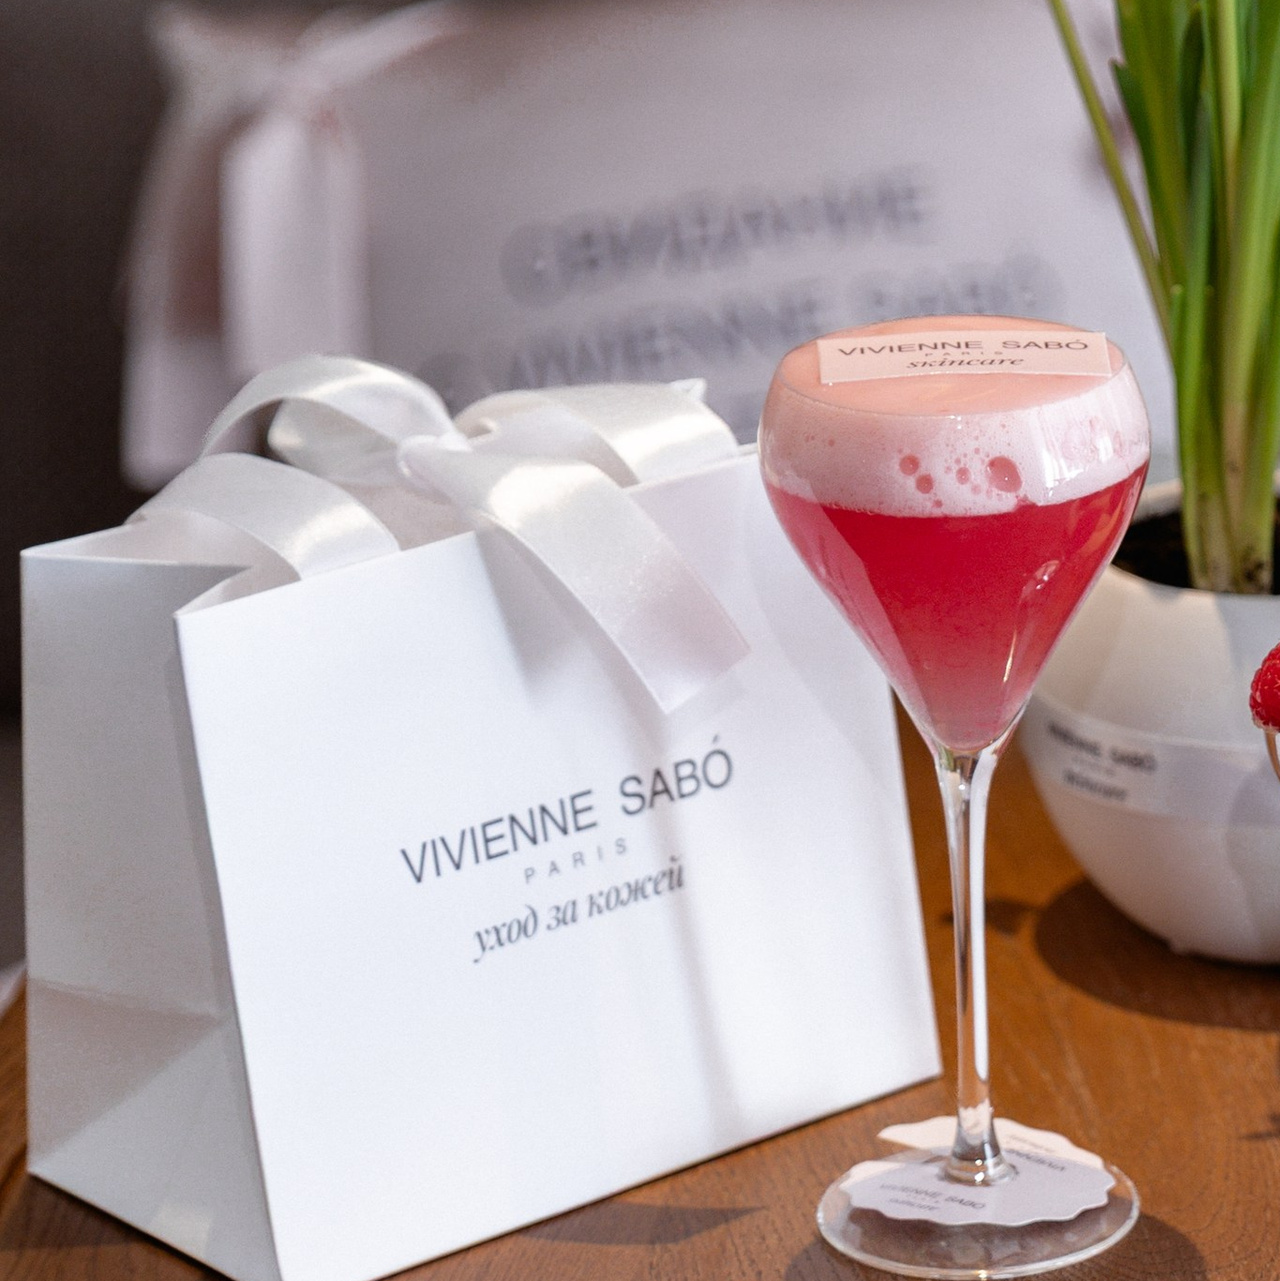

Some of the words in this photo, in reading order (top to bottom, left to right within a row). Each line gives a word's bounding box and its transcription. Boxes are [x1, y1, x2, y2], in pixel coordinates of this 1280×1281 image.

[838, 340, 983, 357] VIVIENNE
[1002, 338, 1089, 351] SABÓ
[906, 356, 1025, 370] skincare
[400, 789, 598, 883] VIVIENNE
[619, 734, 734, 816] SABÓ
[524, 837, 628, 884] PARIS
[473, 904, 539, 963] уход
[546, 898, 579, 932] за
[587, 855, 687, 919] кожей
